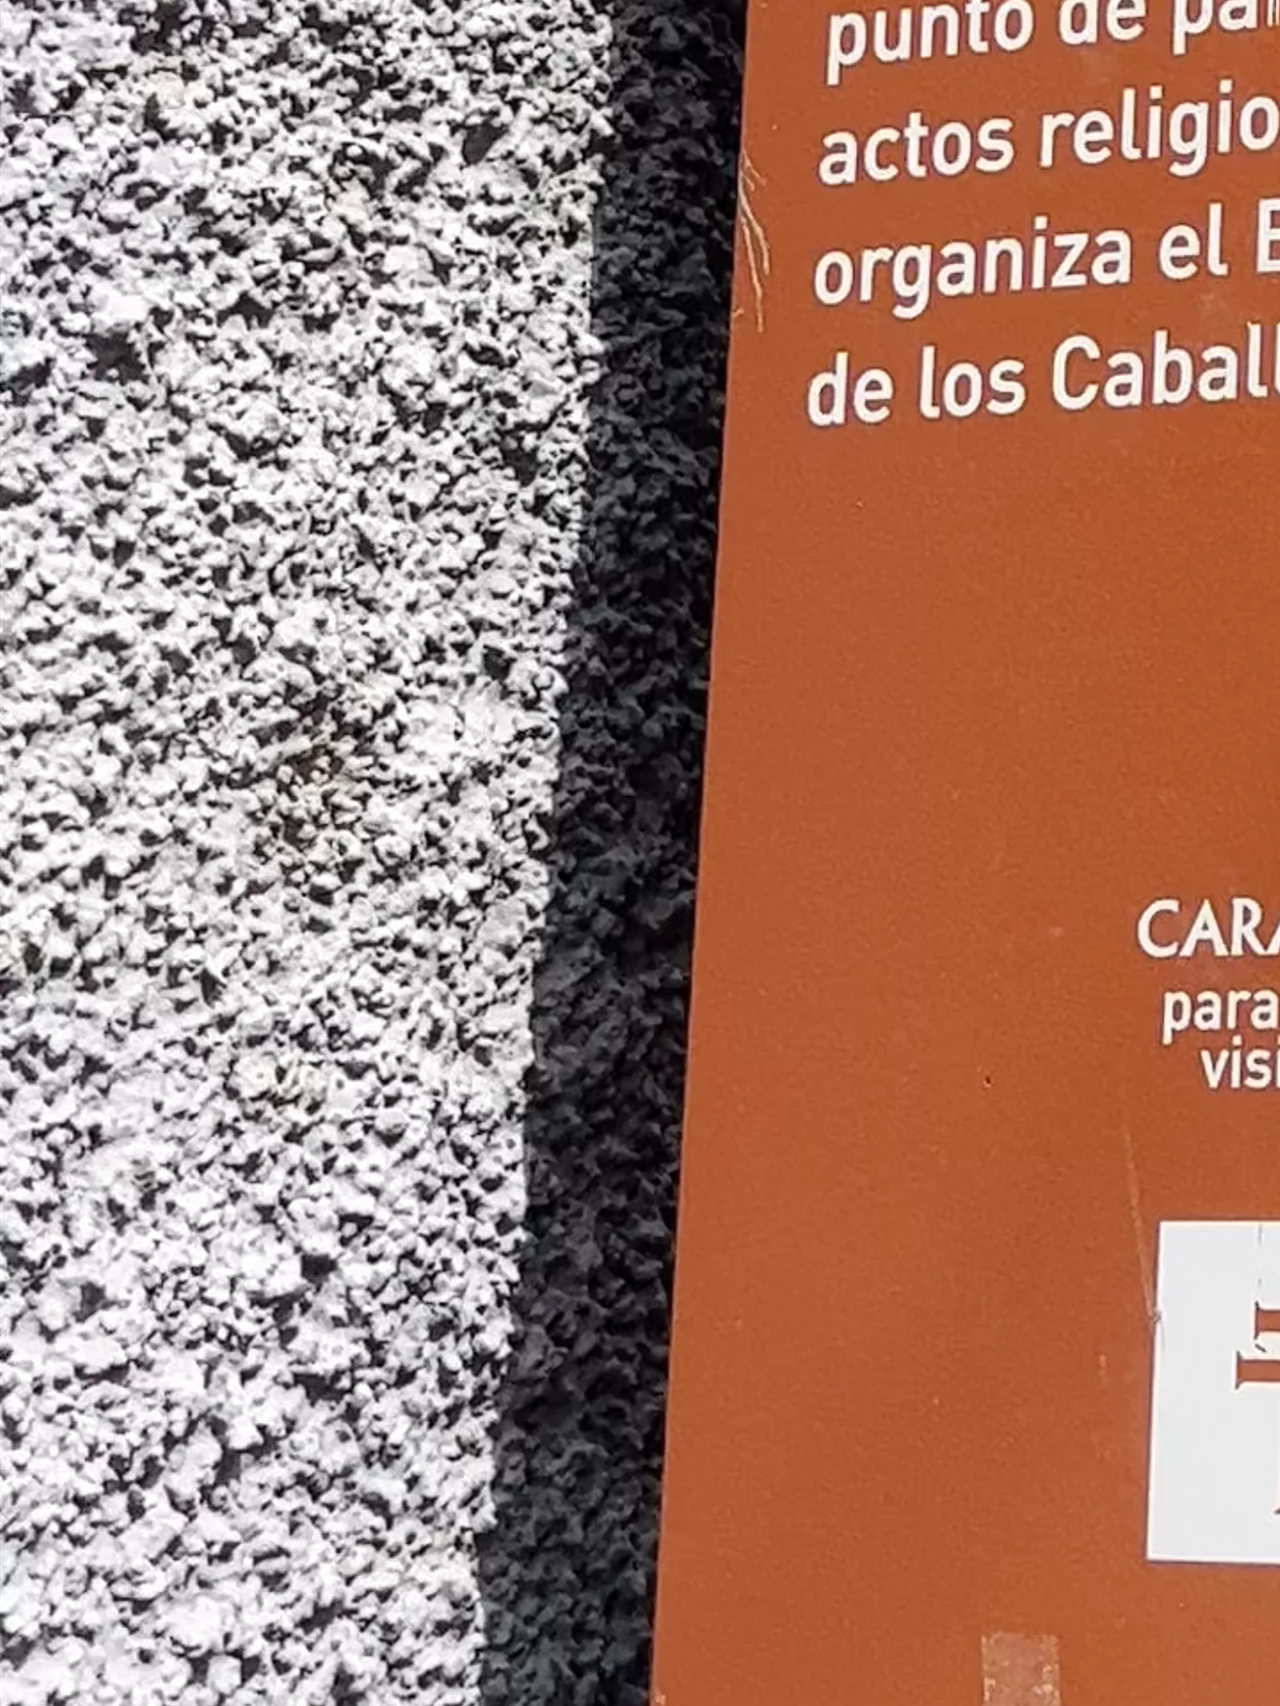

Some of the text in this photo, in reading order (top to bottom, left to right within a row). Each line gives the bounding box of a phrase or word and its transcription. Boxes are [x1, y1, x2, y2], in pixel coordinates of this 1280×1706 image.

[818, 111, 1015, 186] actos
[813, 215, 1132, 320] organiza
[1158, 202, 1229, 281] el
[807, 351, 894, 427] de
[918, 344, 1026, 419] los
[1161, 989, 1280, 1046] para
